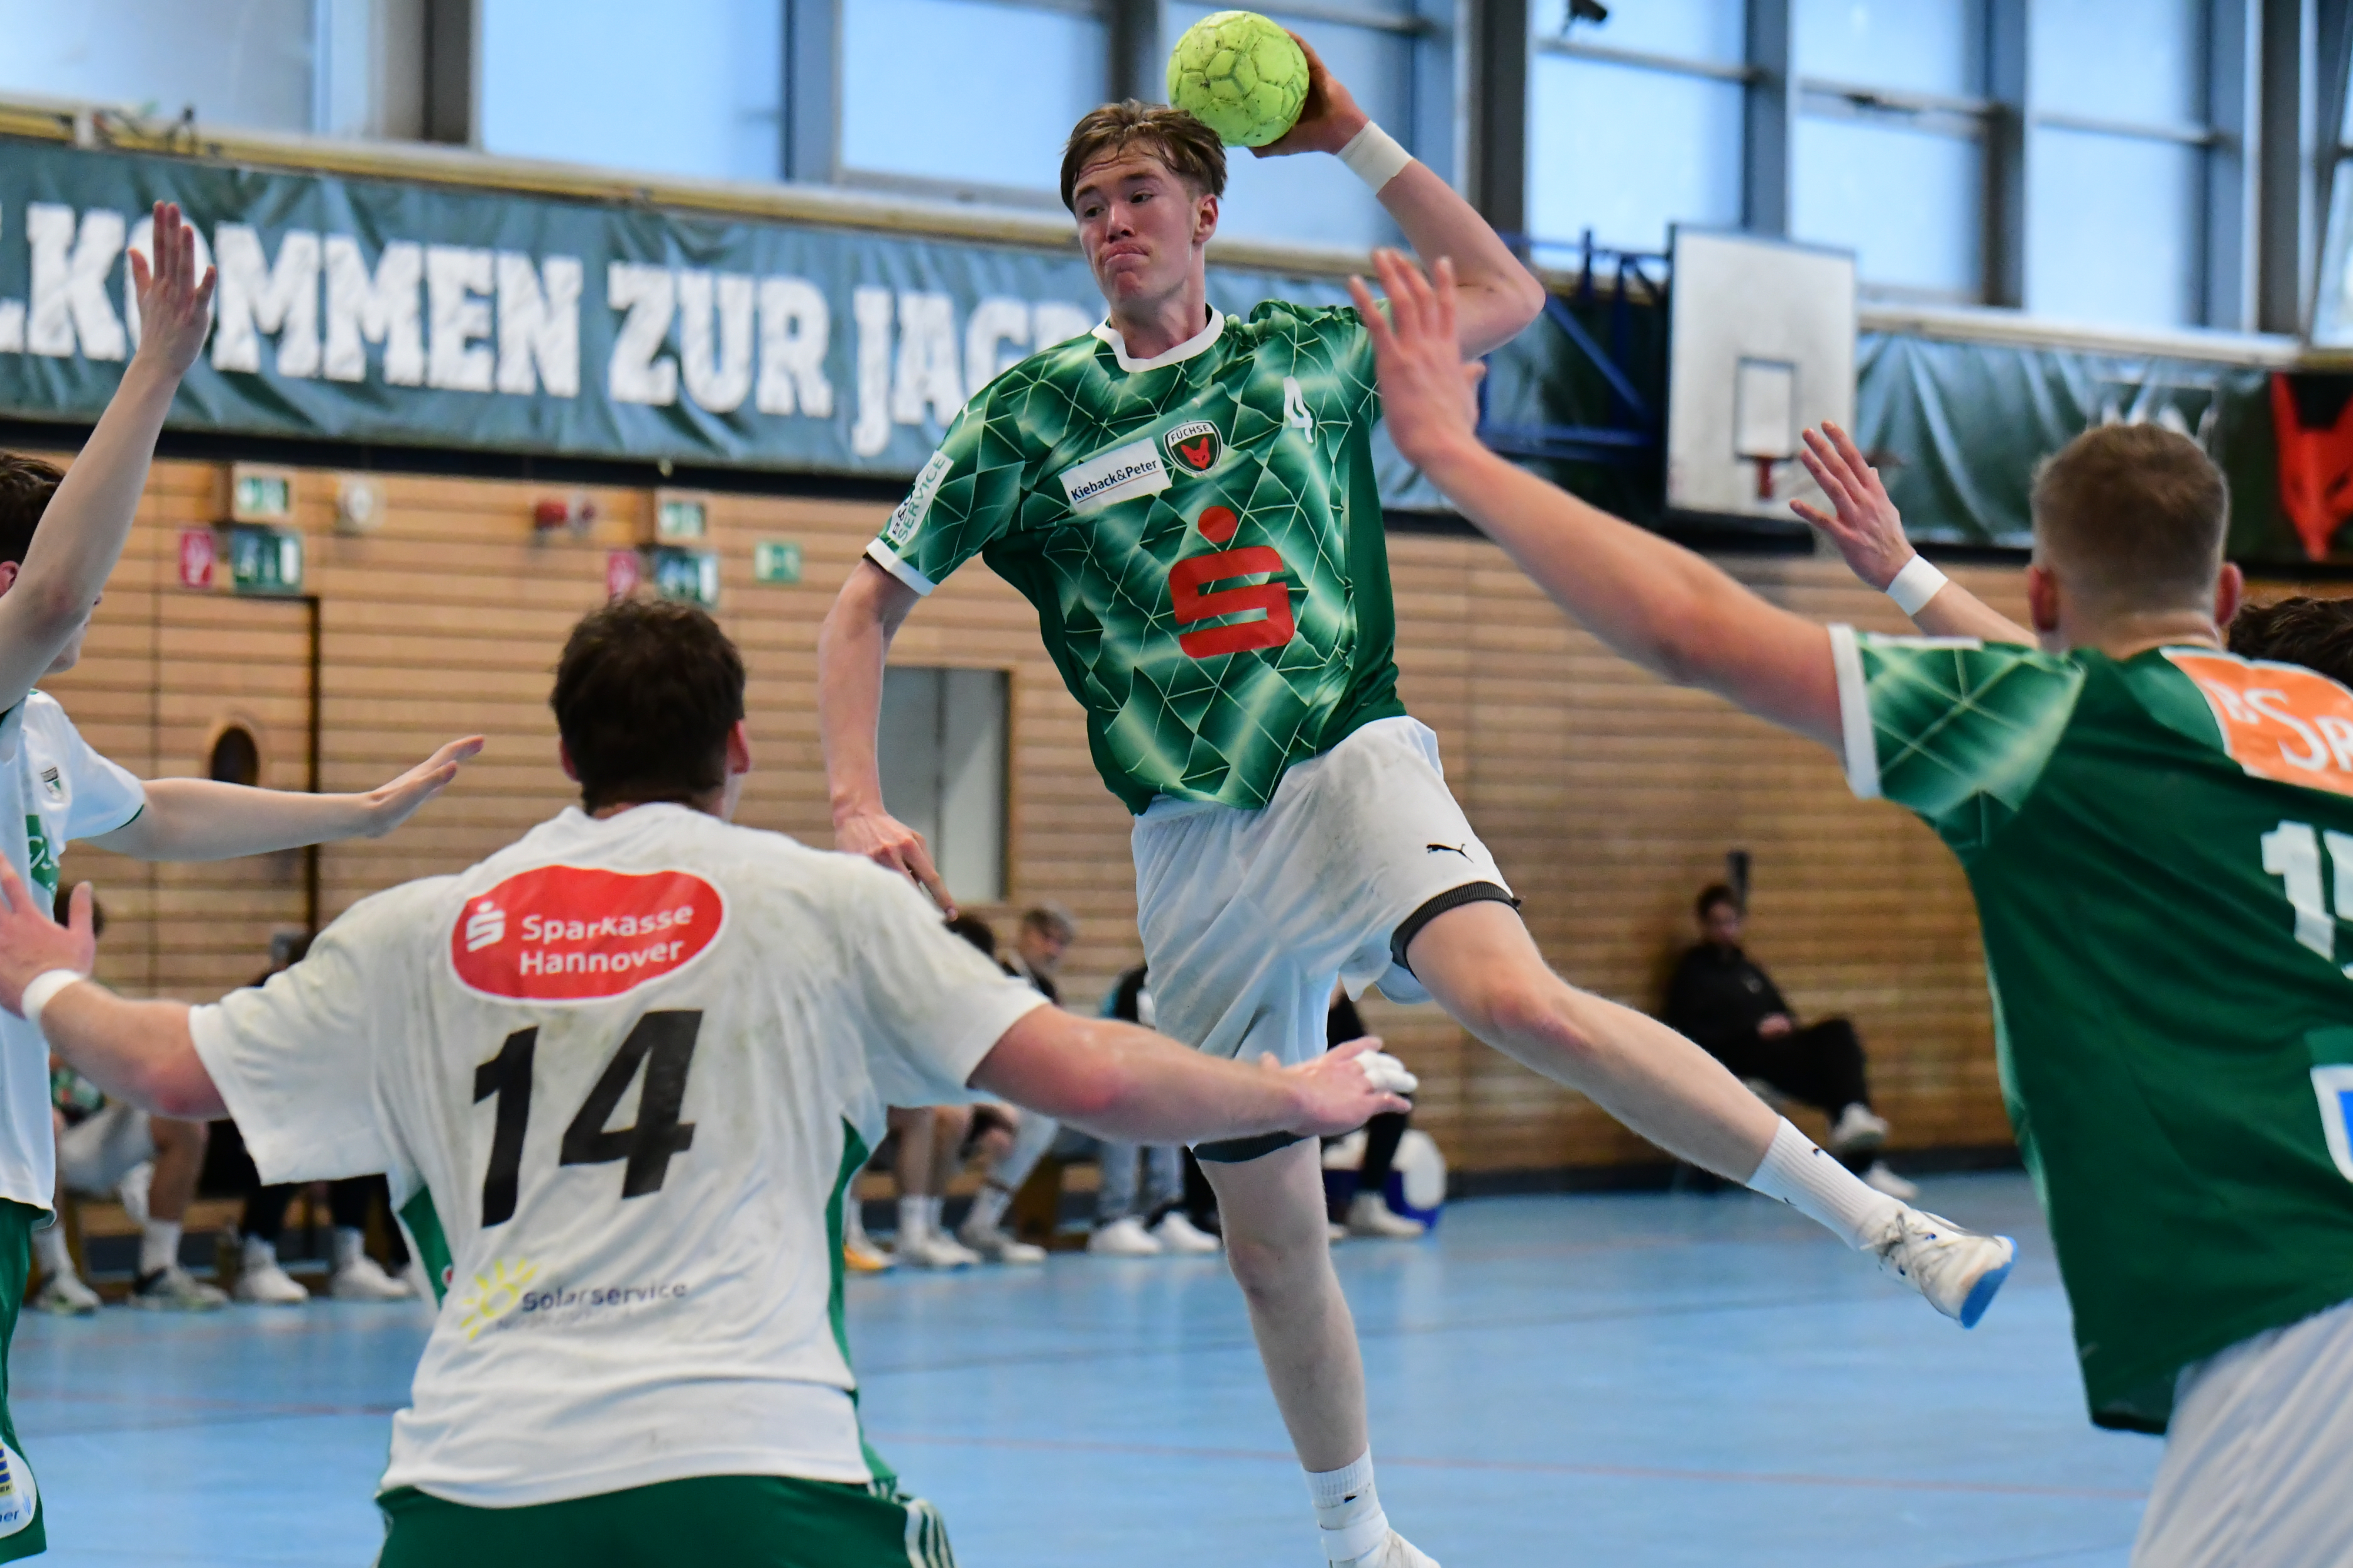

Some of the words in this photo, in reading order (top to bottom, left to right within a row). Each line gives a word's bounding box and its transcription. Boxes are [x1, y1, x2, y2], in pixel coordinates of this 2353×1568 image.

[606, 261, 833, 419] ZUR
[1283, 375, 1314, 444] 4
[897, 455, 946, 542] SERVICE
[1070, 459, 1158, 501] Kieback&Peter
[519, 939, 685, 976] Hannover
[521, 905, 695, 944] Sparkasse
[472, 1009, 704, 1229] 14
